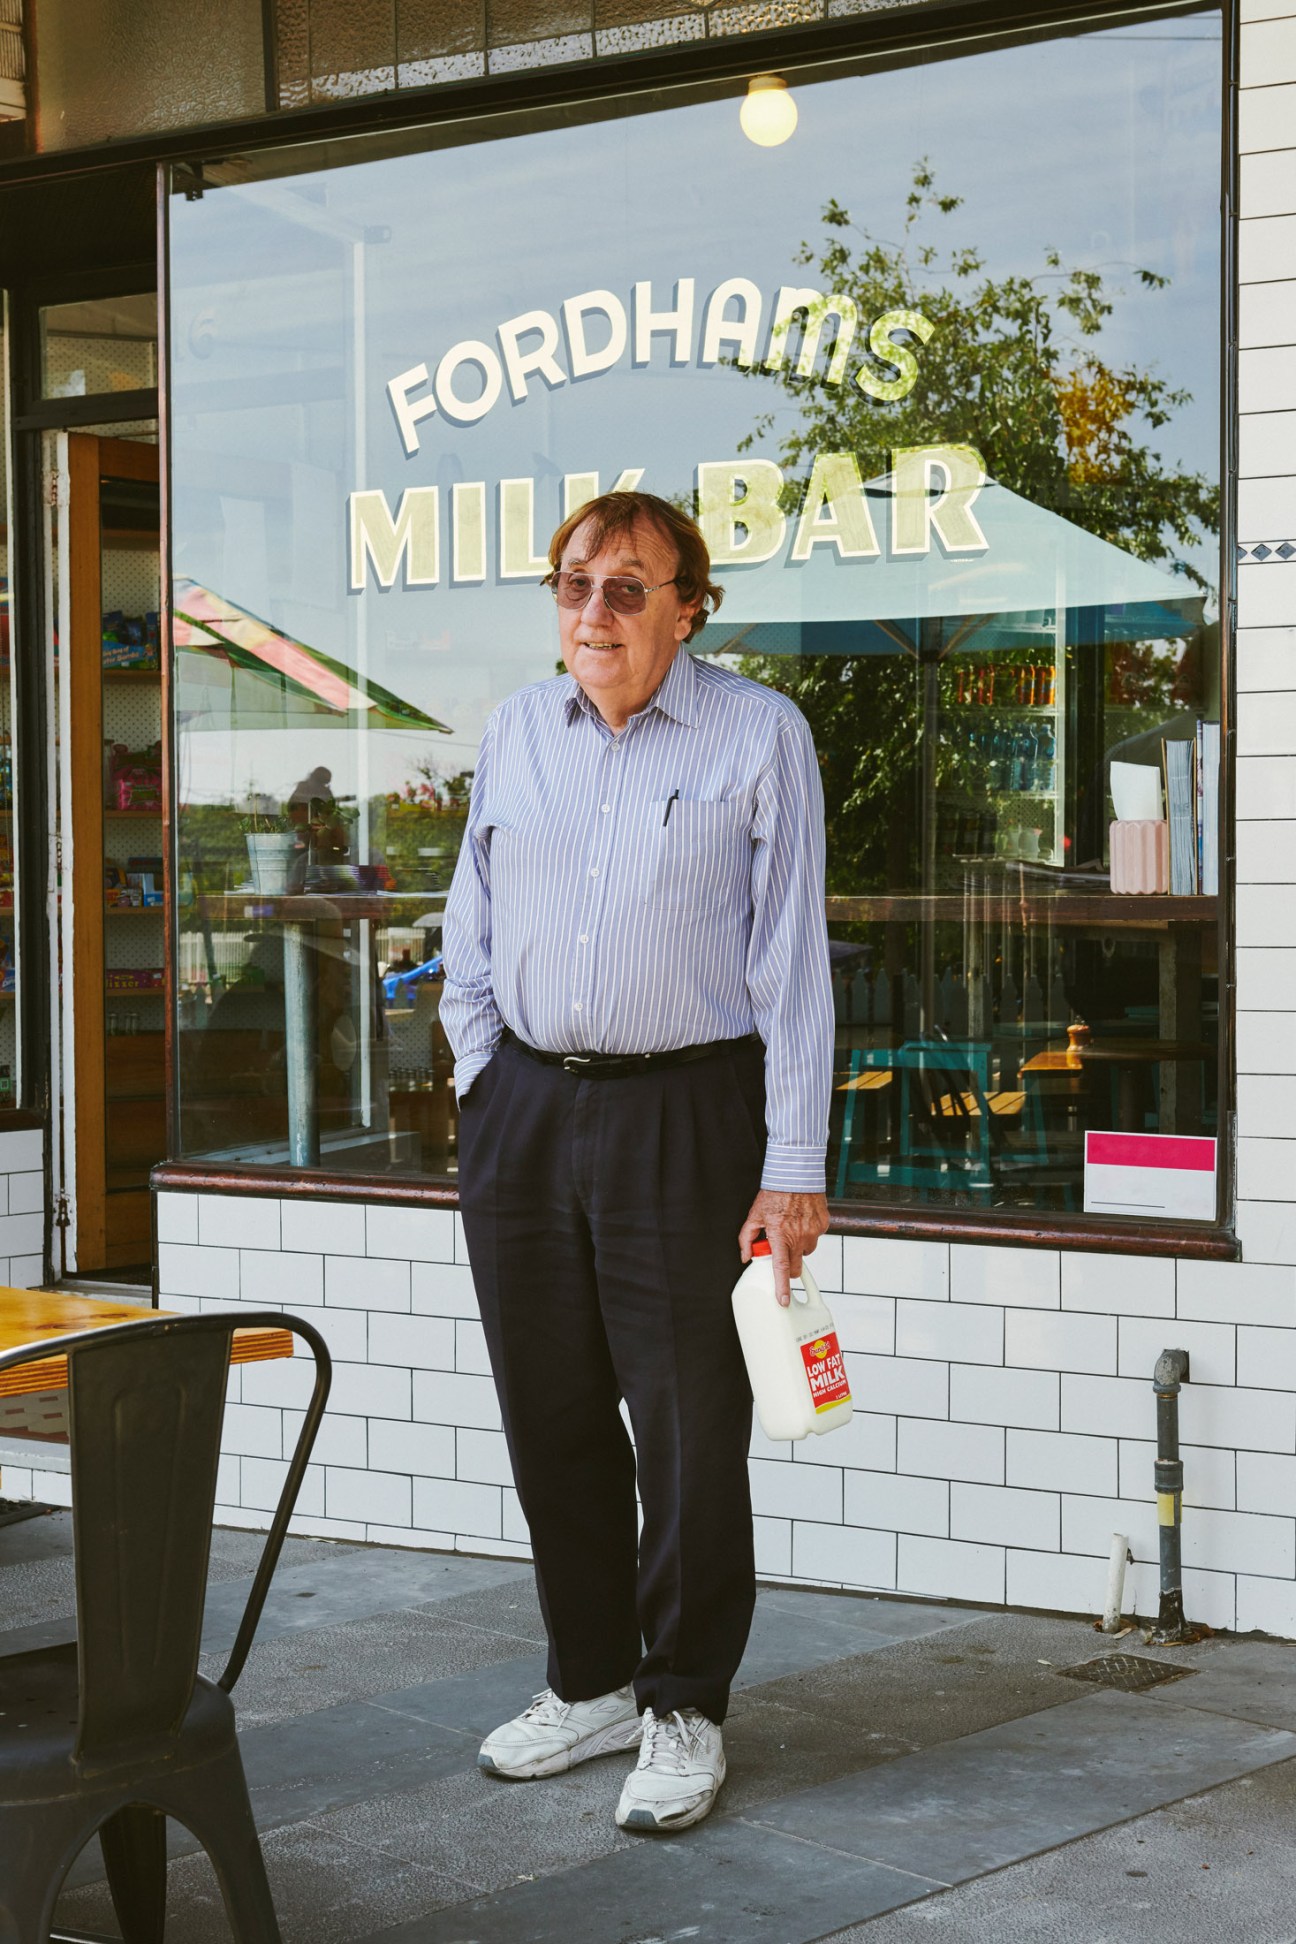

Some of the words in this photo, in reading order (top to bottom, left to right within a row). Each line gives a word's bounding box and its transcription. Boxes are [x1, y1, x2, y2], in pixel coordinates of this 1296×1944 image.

[385, 276, 936, 456] FORDHAMS
[697, 443, 990, 566] BAR
[807, 1360, 825, 1378] LOW
[826, 1353, 841, 1370] FAT
[810, 1365, 846, 1392] MILK
